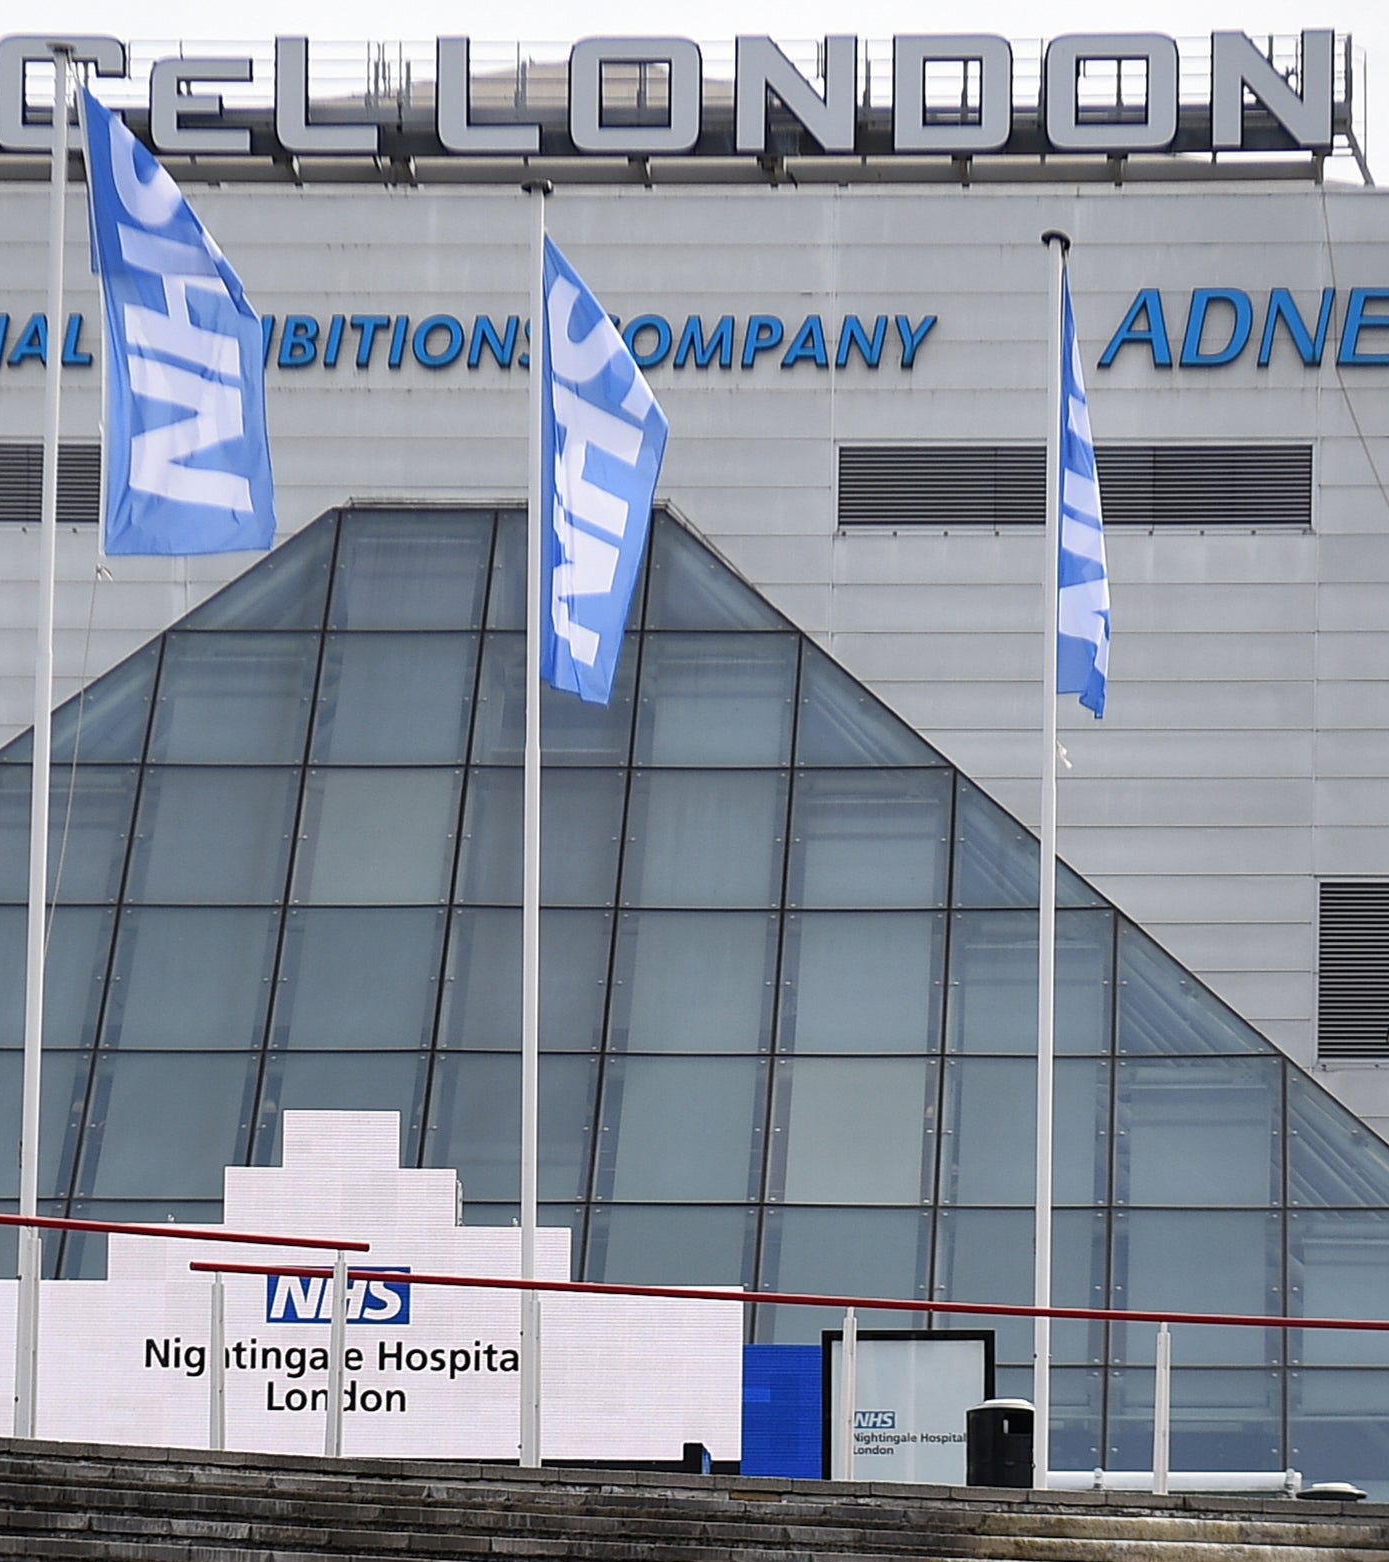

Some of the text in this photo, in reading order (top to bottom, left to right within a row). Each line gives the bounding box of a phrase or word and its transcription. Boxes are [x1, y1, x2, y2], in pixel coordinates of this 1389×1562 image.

[436, 29, 1335, 154] LONDON
[109, 116, 255, 513] NHS
[608, 313, 938, 370] OMPANY
[268, 1270, 403, 1321] NHS
[144, 1337, 520, 1380] Nigtingae Hospita
[266, 1380, 408, 1413] London
[853, 1432, 967, 1445] Nightingale Hospital
[854, 1411, 895, 1429] NHS
[853, 1445, 894, 1455] London
